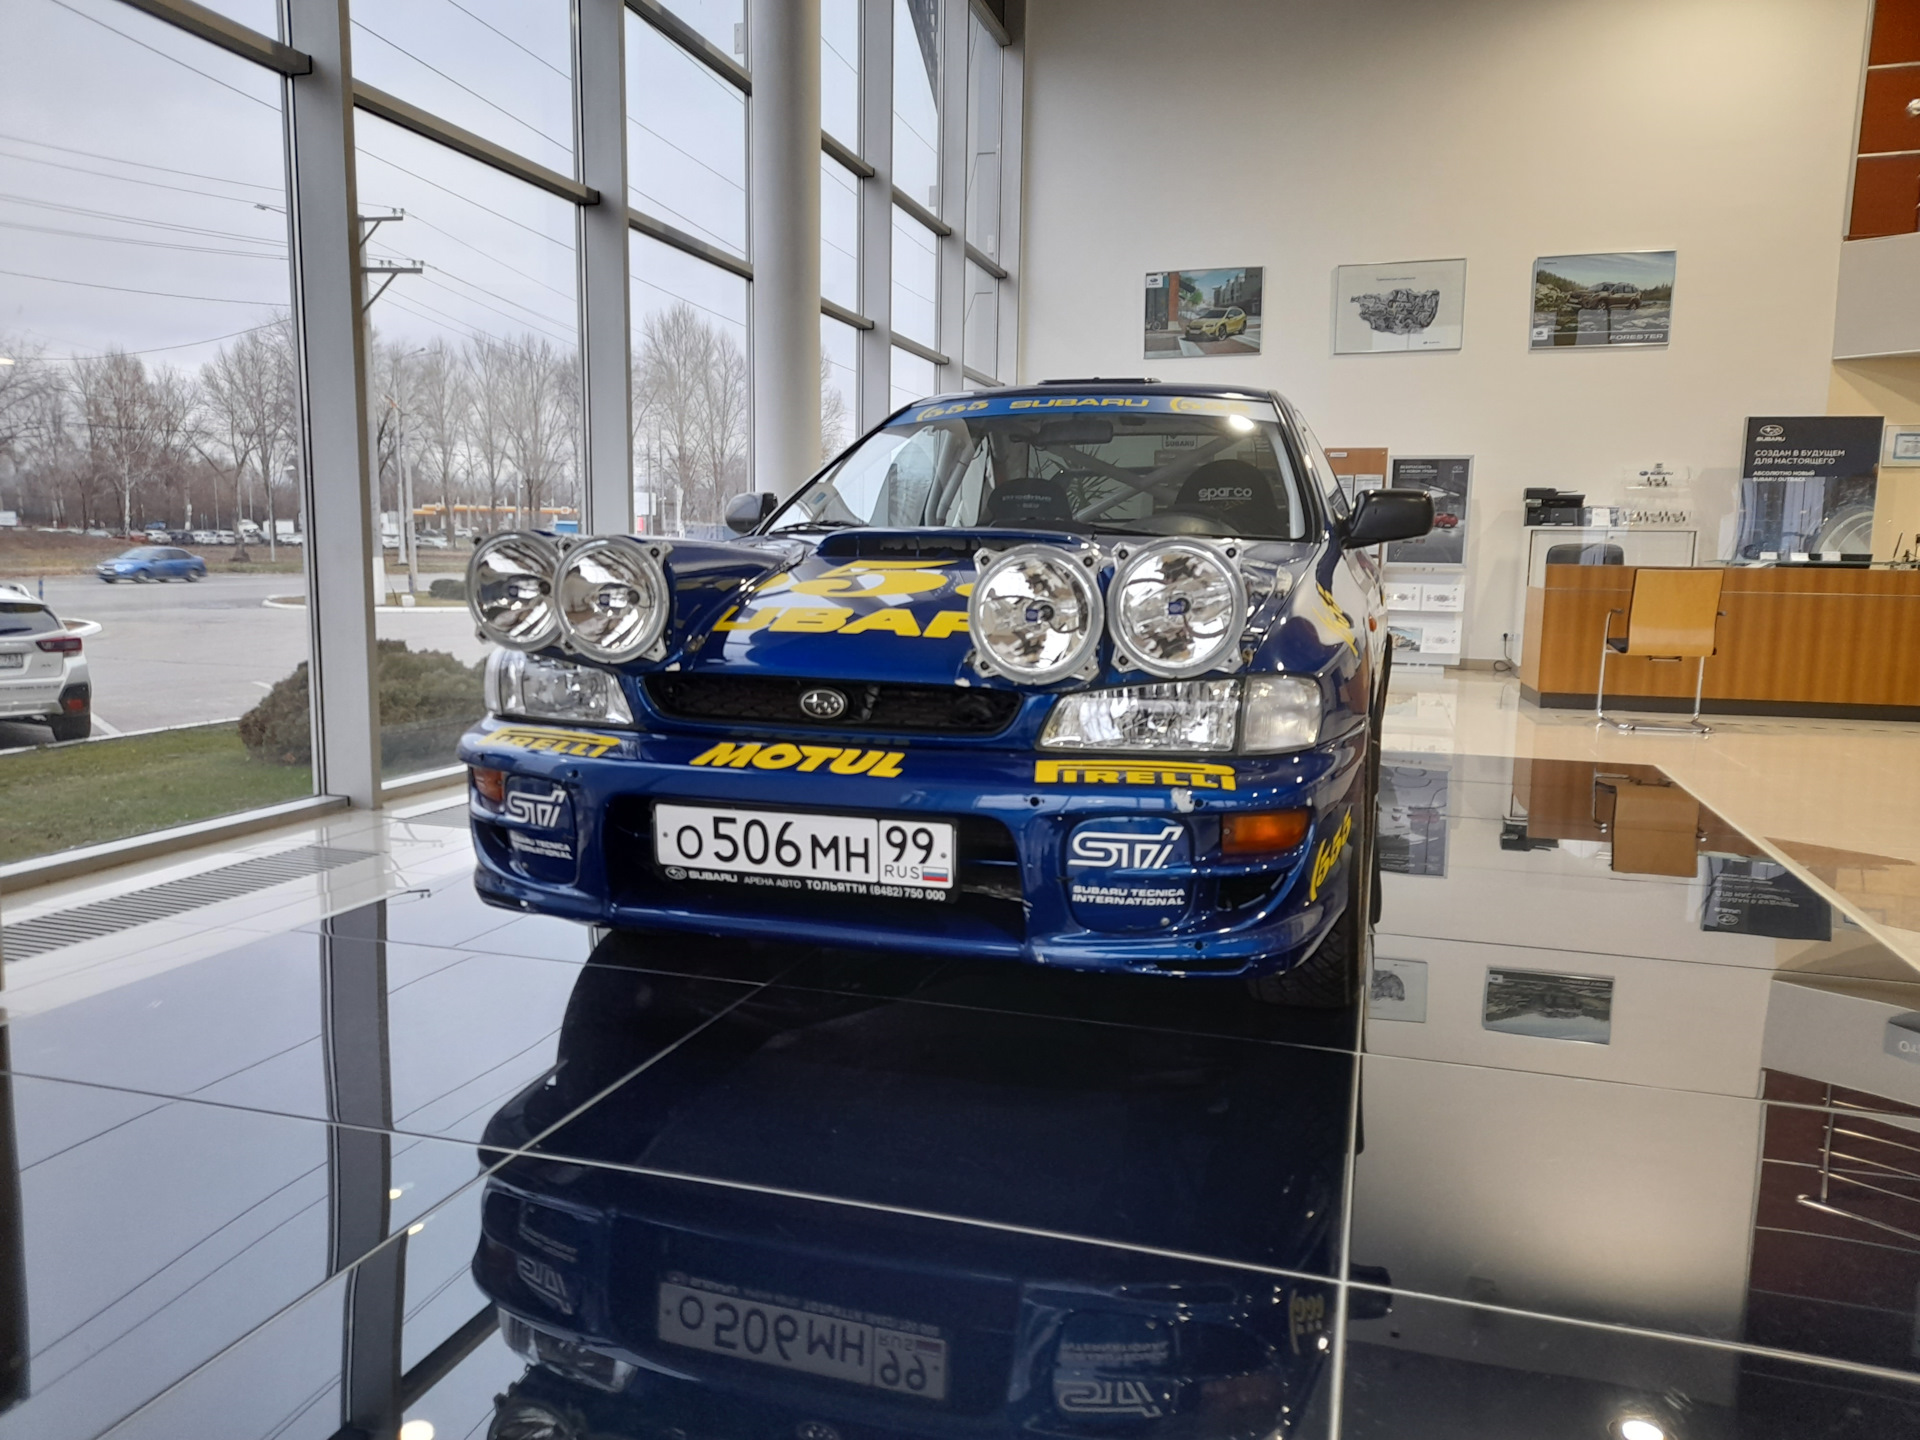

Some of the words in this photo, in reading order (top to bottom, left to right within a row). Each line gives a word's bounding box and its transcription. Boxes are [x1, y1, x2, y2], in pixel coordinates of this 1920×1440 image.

[1609, 333, 1664, 341] FORESTER
[1009, 398, 1149, 410] SUBARU
[1754, 449, 1792, 457] СОЗДАН
[1800, 450, 1845, 458] БУДУЩЕМ
[1753, 458, 1773, 466] ДЛЯ
[1774, 458, 1836, 466] НАСТОЯЩЕГО
[1198, 487, 1253, 501] sparco
[475, 726, 622, 758] PIRELLI
[689, 742, 906, 778] MOTUL
[1034, 760, 1236, 791] PIRELLI
[885, 825, 934, 865] 99
[884, 864, 920, 880] RUS
[688, 870, 738, 883] SUBARU
[743, 876, 775, 887] АРЕНА
[776, 879, 802, 889] АВТО
[805, 879, 867, 894] ТОЛЬЯТТИ
[869, 885, 903, 897] (8482)
[904, 887, 924, 900] 750
[925, 889, 946, 902] 000
[1072, 885, 1128, 897] SUBARU
[1130, 888, 1185, 898] TECNICA
[1072, 894, 1185, 906] INTERNATIONAL
